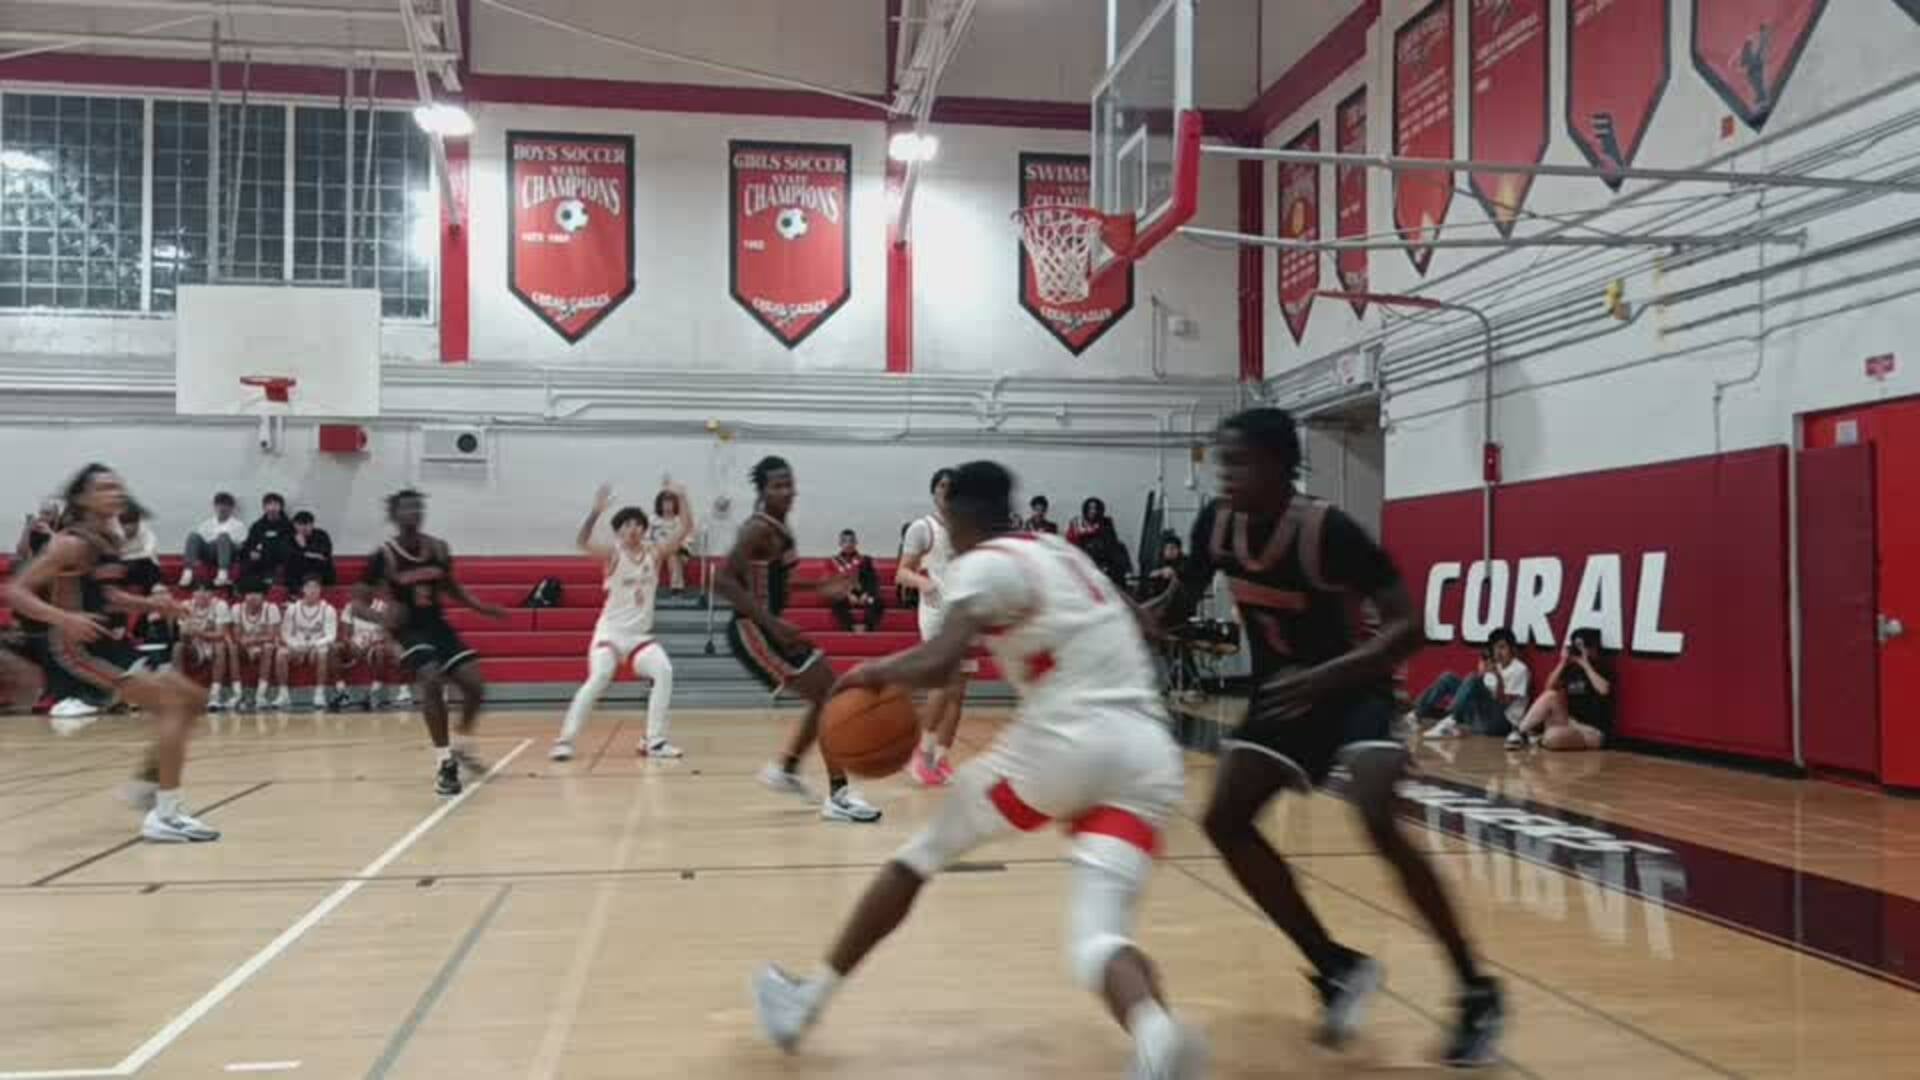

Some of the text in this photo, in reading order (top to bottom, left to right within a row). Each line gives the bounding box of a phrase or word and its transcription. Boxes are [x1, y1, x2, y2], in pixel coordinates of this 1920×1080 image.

[513, 144, 626, 164] BOYS SOCCER
[732, 153, 849, 174] GIRLS SOCCER
[523, 175, 620, 215] CHAMPIONS
[745, 184, 838, 224] CHAMPIONS
[1424, 552, 1685, 654] CORAL
